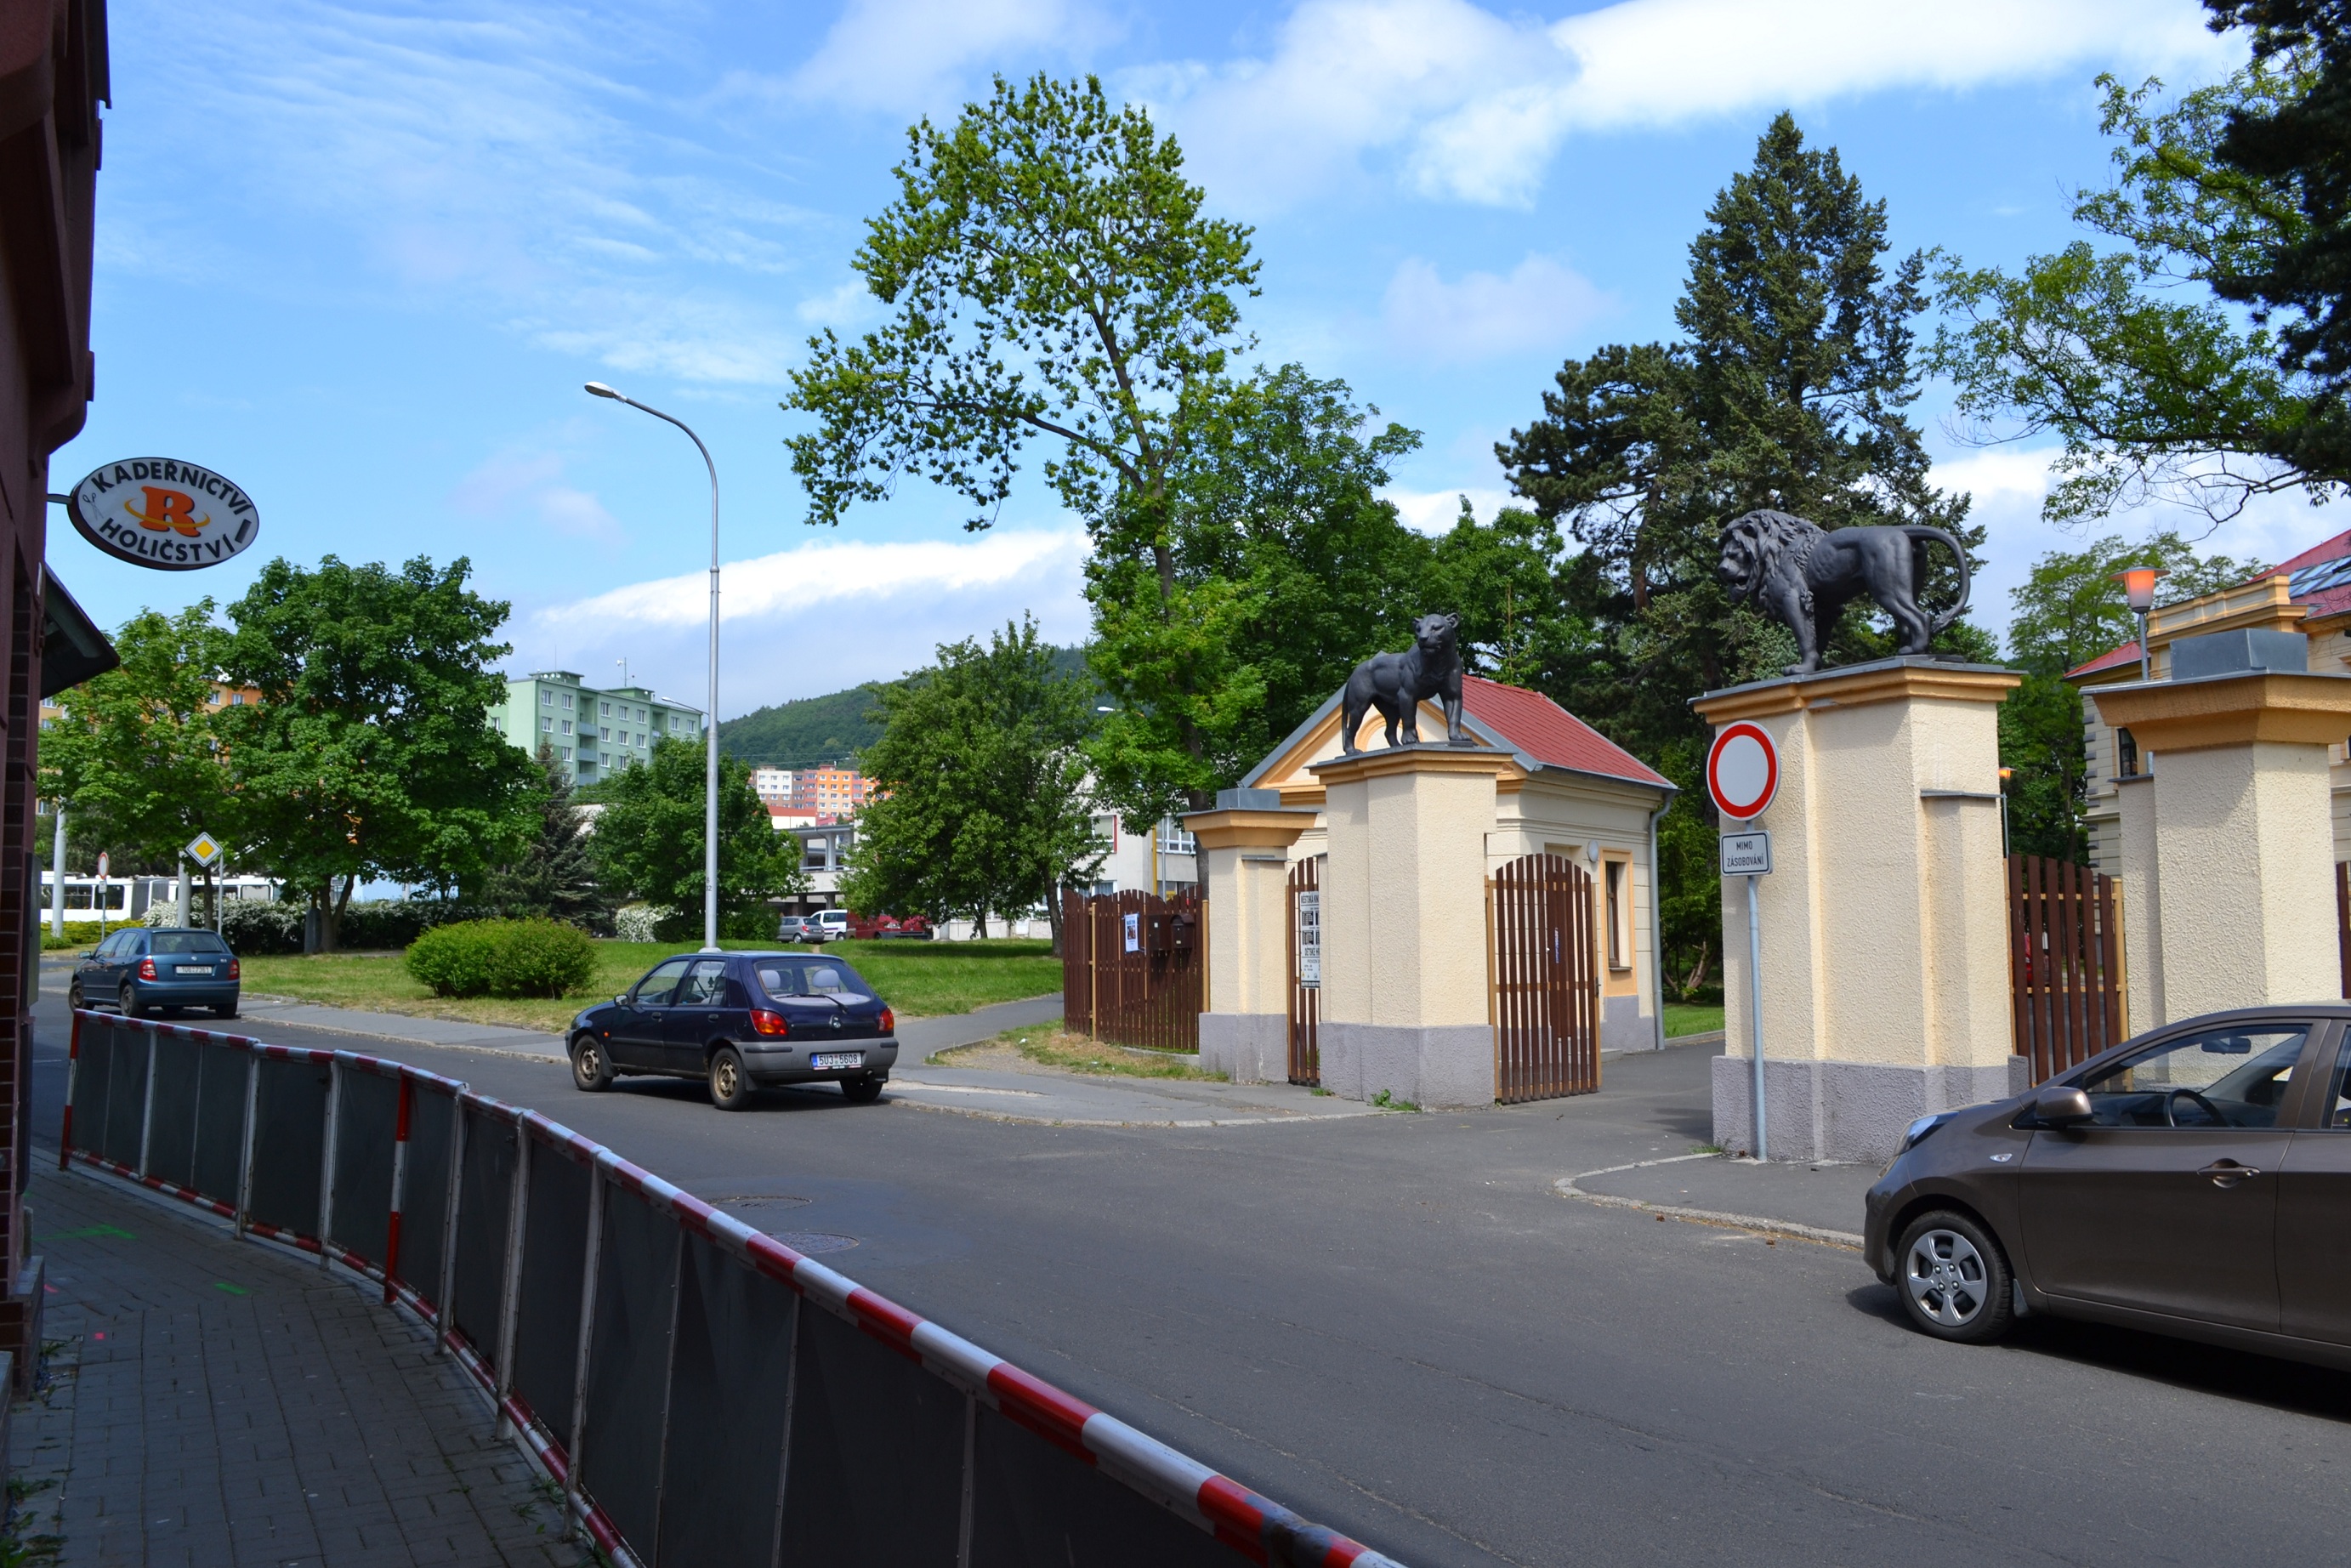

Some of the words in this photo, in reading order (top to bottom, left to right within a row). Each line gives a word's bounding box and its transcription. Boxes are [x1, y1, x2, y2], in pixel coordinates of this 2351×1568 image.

[91, 460, 253, 515] KADEŘNICTVÍ
[139, 486, 202, 537] R
[99, 518, 235, 562] HOLIČSTVÍ
[1727, 853, 1763, 867] ZÁSOBOVÁNÍ
[1736, 840, 1752, 851] MIMO
[819, 1055, 833, 1065] 5U3
[838, 1054, 858, 1064] 5608
